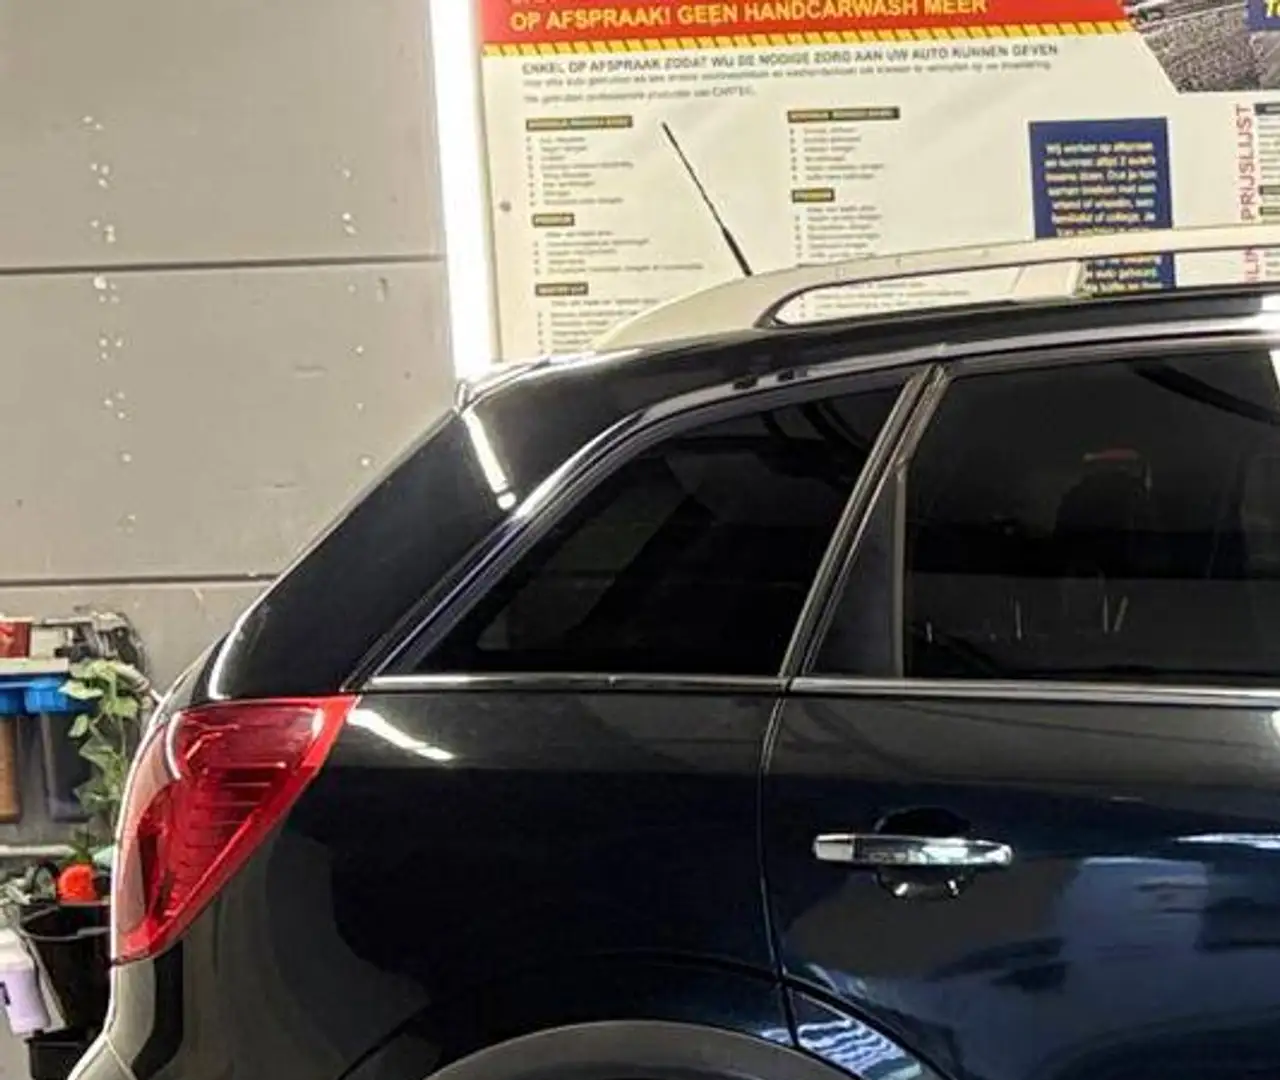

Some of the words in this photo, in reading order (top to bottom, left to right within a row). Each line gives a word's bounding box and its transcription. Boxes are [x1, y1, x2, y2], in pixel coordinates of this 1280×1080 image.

[509, 11, 541, 33] OP
[546, 4, 671, 30] AFSPRAAK!
[676, 3, 738, 26] GEEN
[743, 0, 919, 22] HANDCARWASH
[923, 0, 989, 14] MEER
[590, 57, 661, 73] AFSPRAAK
[854, 48, 883, 62] AAN
[911, 46, 949, 60] AUTO
[1235, 104, 1257, 223] PRIJSLIJST
